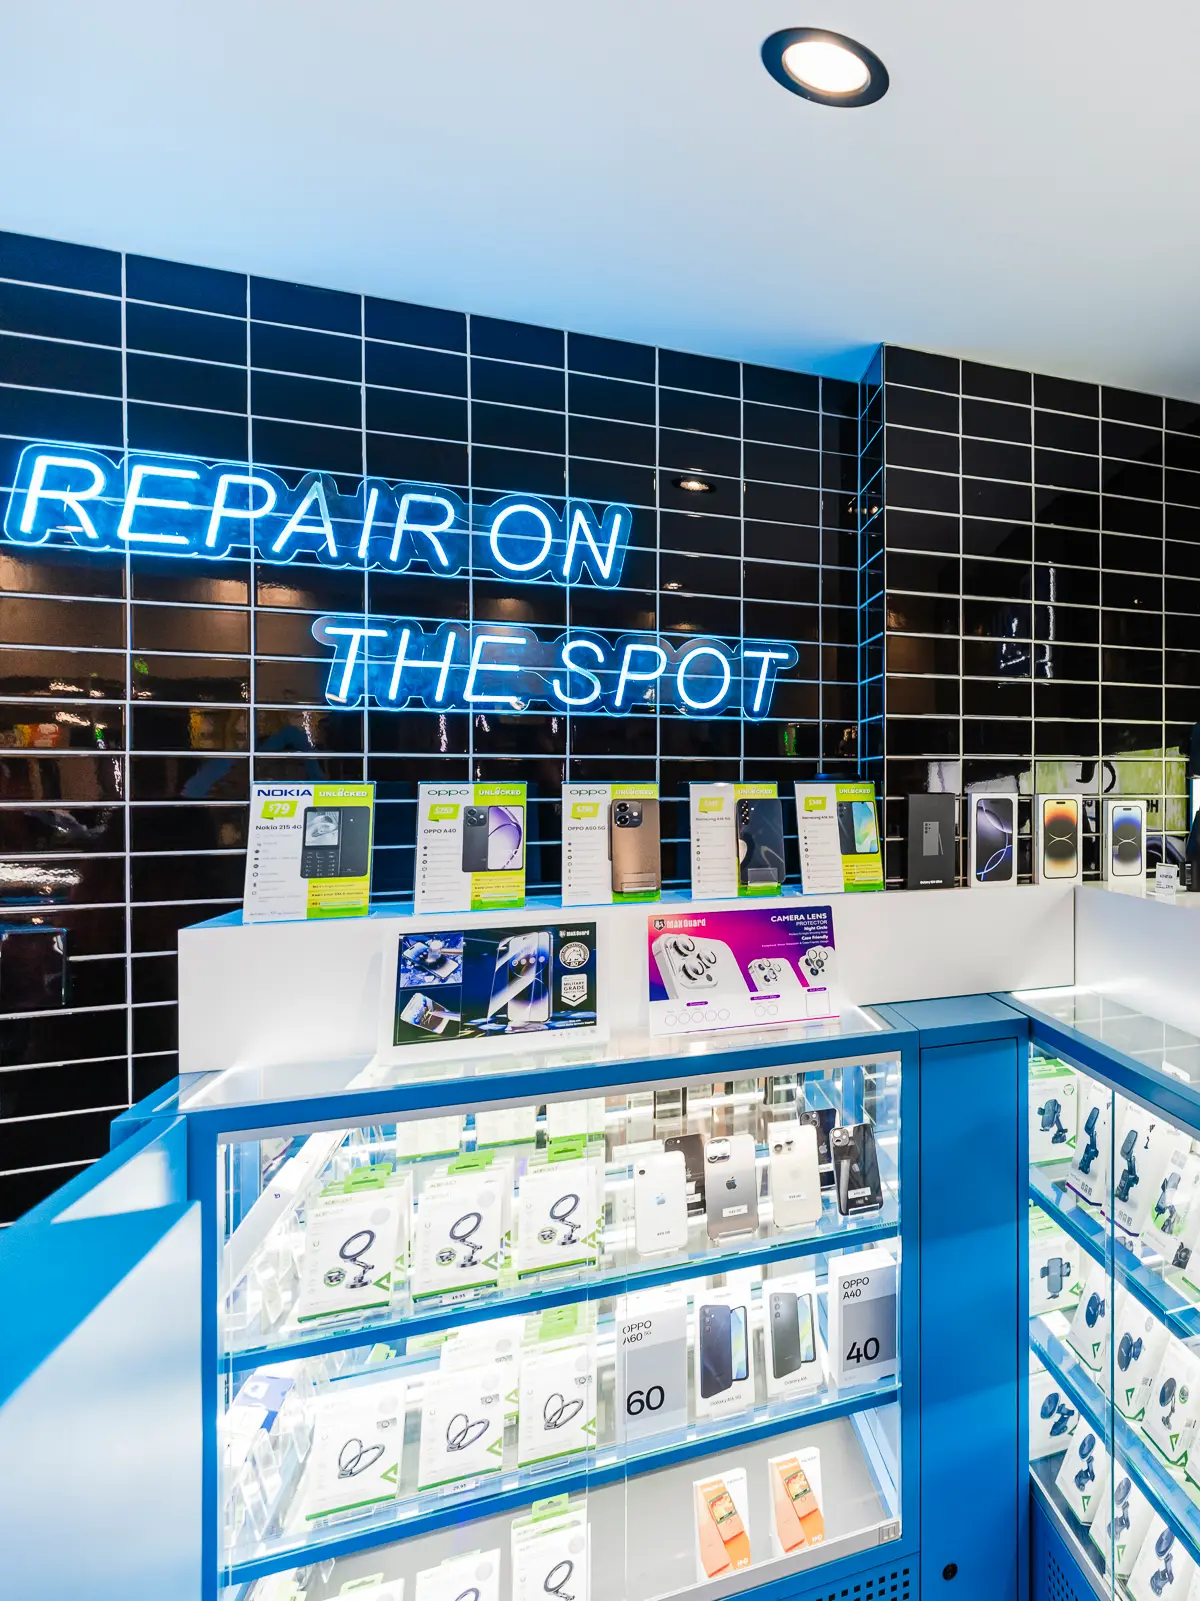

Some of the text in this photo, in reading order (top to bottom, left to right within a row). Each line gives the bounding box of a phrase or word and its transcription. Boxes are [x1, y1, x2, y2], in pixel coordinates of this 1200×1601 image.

[18, 454, 625, 581] REPAIR ON
[322, 625, 792, 714] THE SPOT
[257, 789, 312, 797] NOKIA
[319, 787, 368, 797] UNLOCKED
[478, 787, 521, 796] UNLOCKED
[615, 787, 654, 796] UNLOCKED
[737, 786, 773, 795] UNLOCKED
[839, 785, 871, 795] UNLOCKED
[268, 803, 291, 815] $79
[770, 912, 827, 922] CAMERA LENS
[842, 1276, 870, 1290] OPPO
[842, 1288, 862, 1300] A40
[622, 1319, 652, 1335] OPPO
[622, 1332, 643, 1345] A60
[846, 1336, 880, 1364] 40
[626, 1384, 665, 1416] 60
